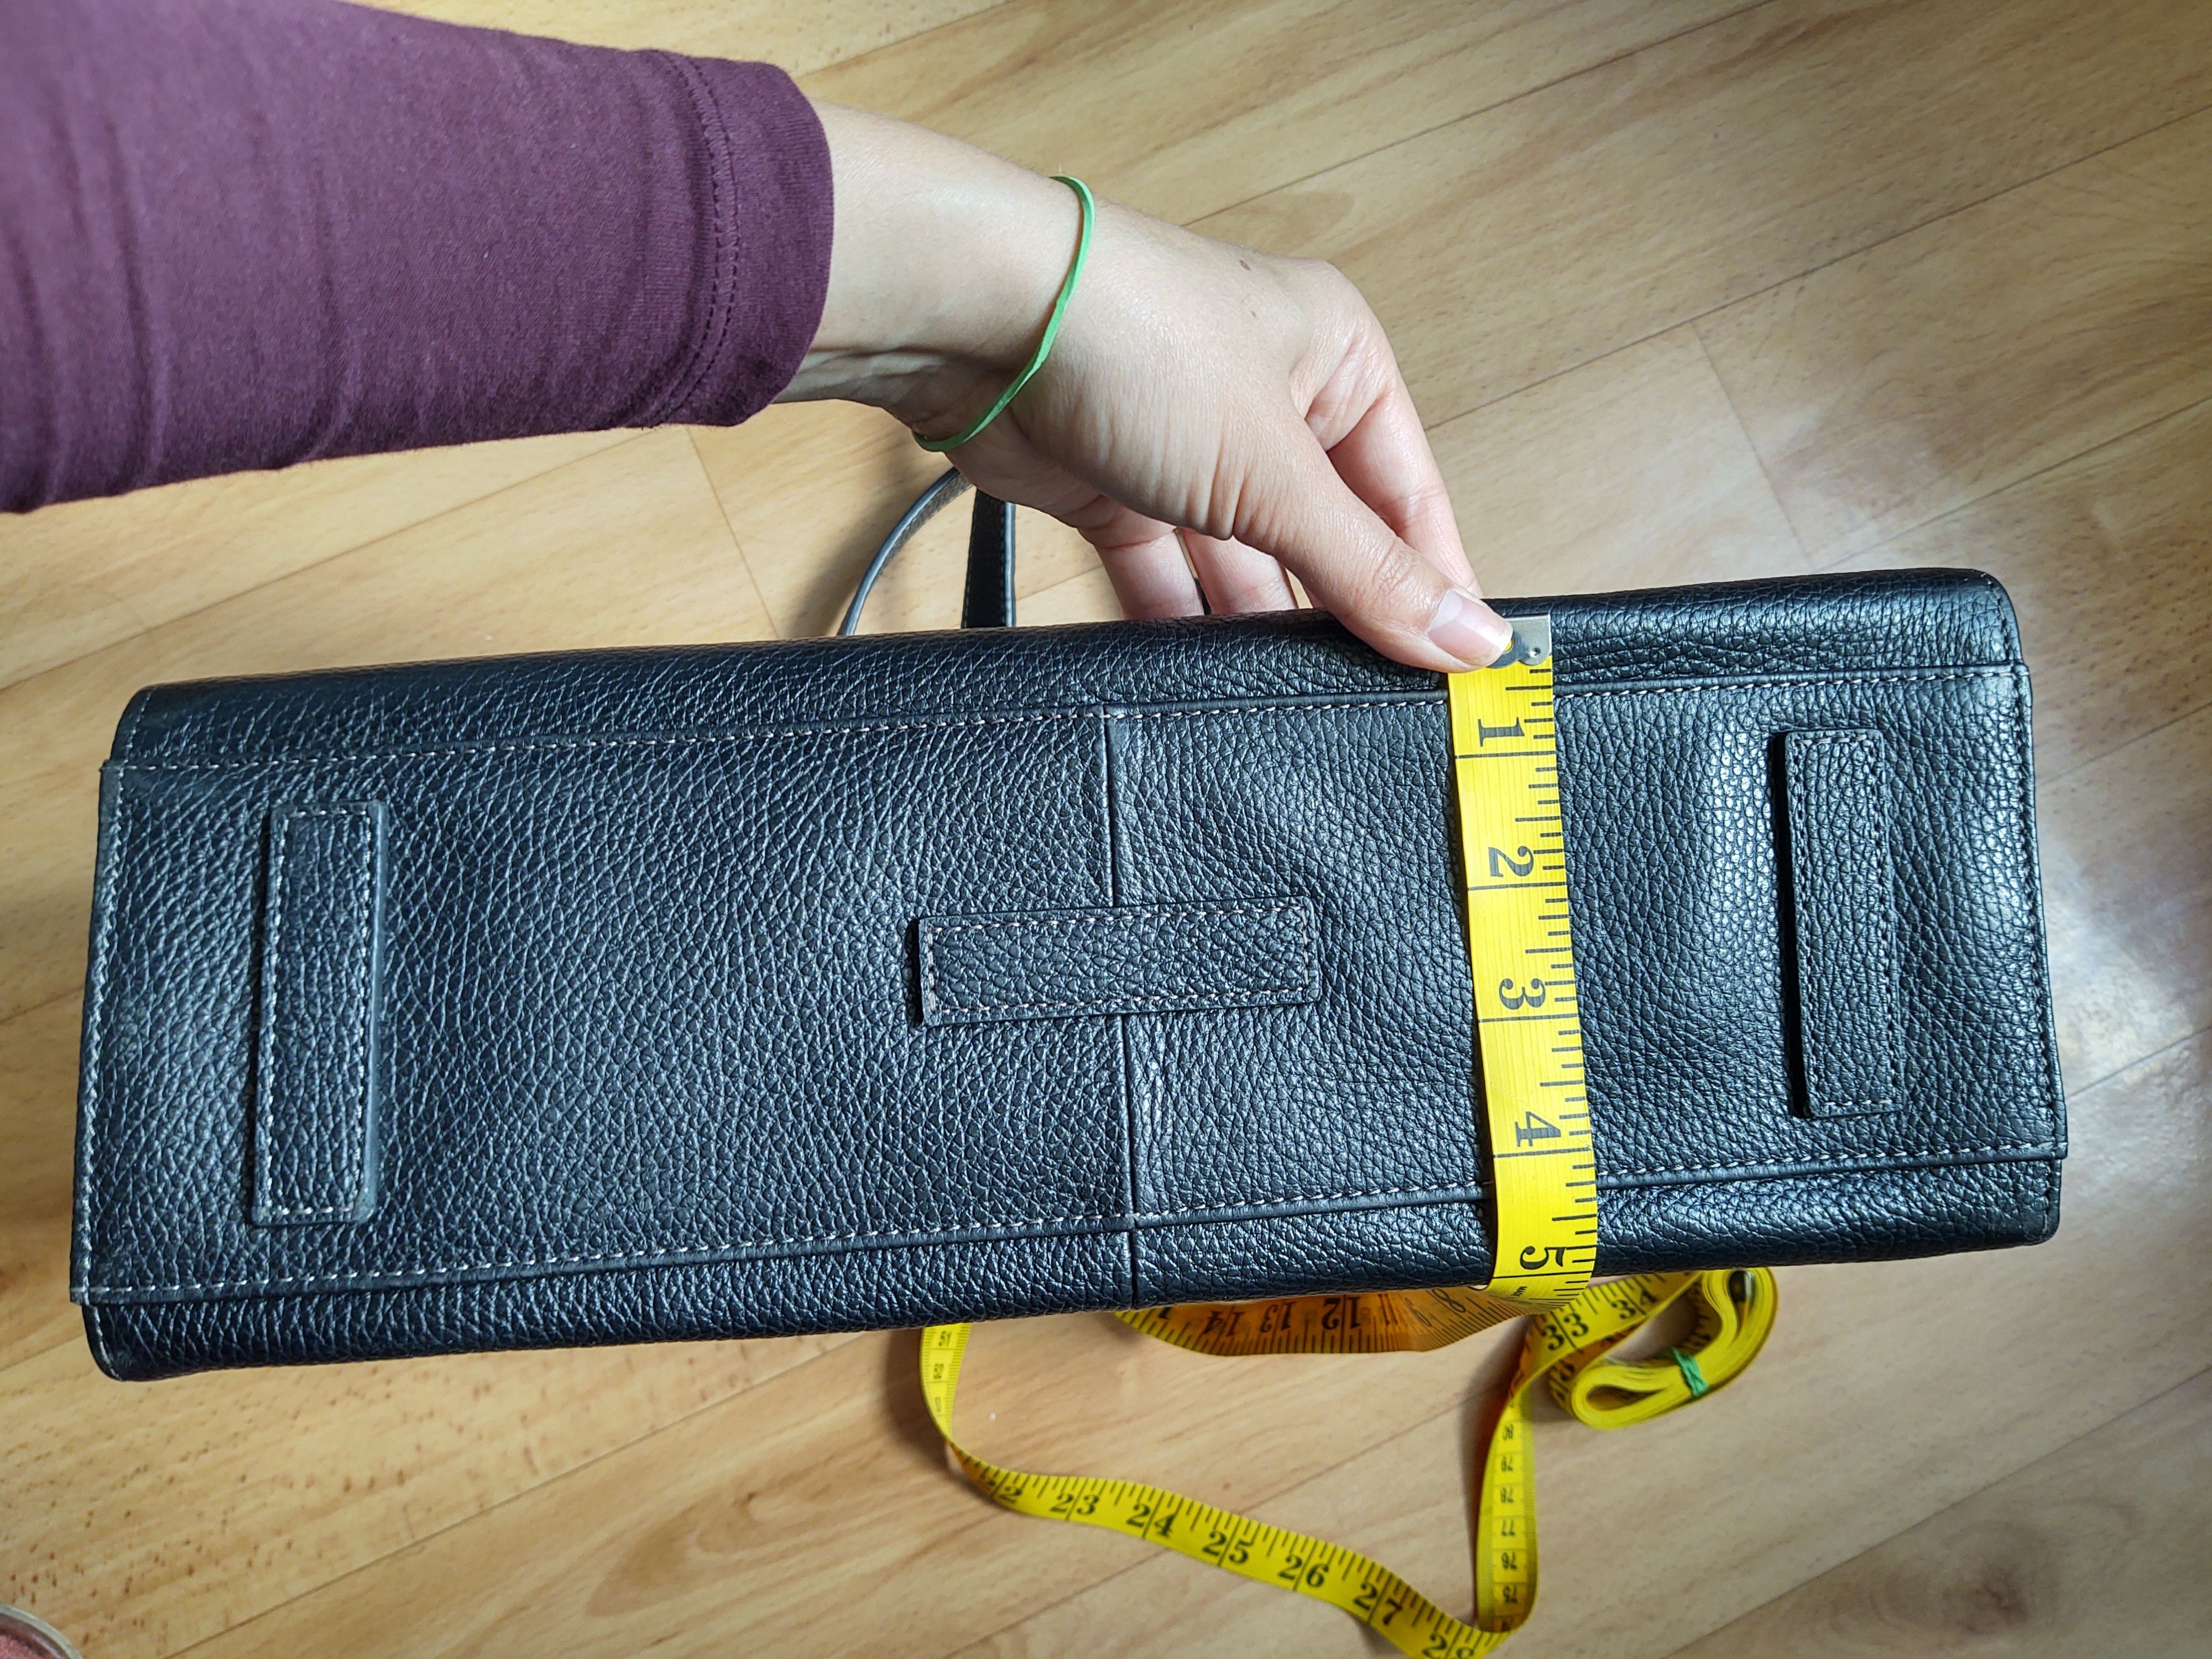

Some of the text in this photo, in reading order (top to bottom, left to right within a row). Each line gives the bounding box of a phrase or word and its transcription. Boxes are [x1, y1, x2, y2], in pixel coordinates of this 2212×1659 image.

[1478, 717, 1567, 1270] 1 2 3 4 5
[1260, 1301, 1297, 1333] 13
[1322, 1296, 1361, 1330] 12
[1431, 1288, 1467, 1313] 8
[1201, 1311, 1244, 1337] 14
[1541, 1313, 1589, 1350] 33
[1501, 1518, 1516, 1536] 77
[1050, 1492, 1100, 1516] 23
[1125, 1503, 1175, 1538] 24
[1201, 1530, 1255, 1565] 25
[1277, 1554, 1330, 1589] 26
[1351, 1582, 1402, 1626] 27
